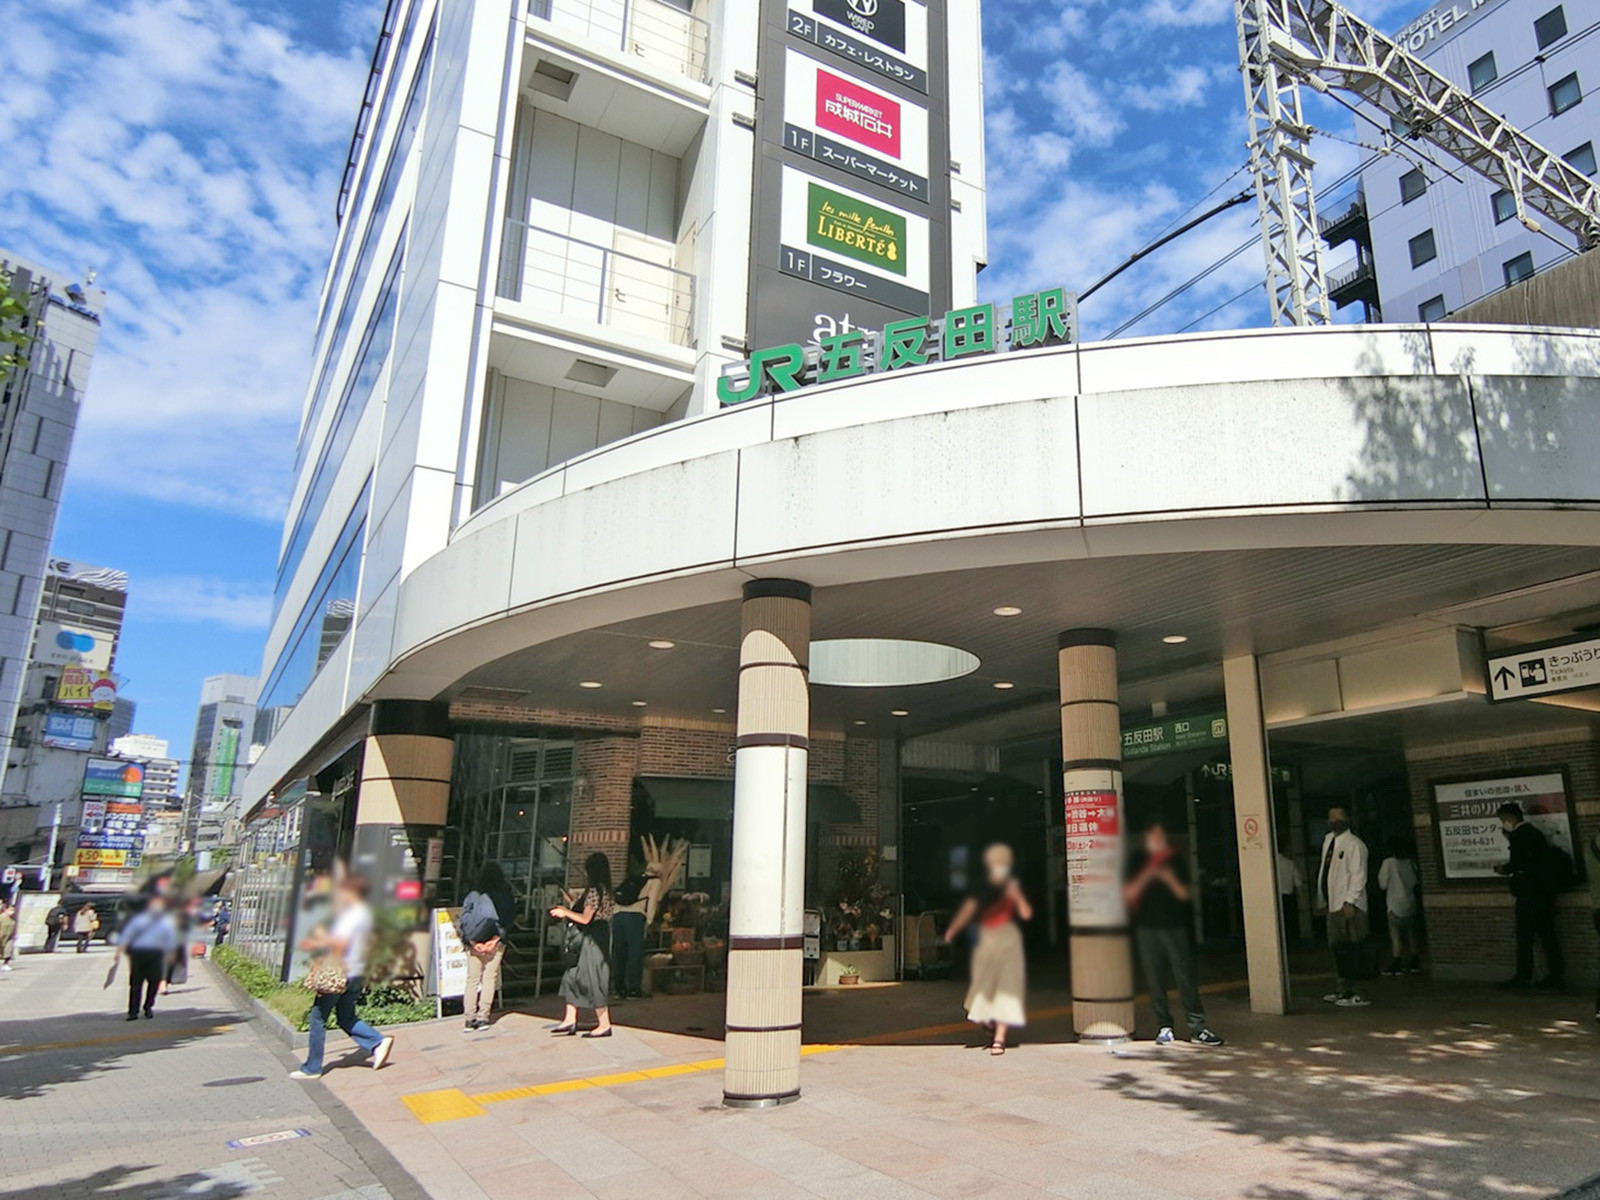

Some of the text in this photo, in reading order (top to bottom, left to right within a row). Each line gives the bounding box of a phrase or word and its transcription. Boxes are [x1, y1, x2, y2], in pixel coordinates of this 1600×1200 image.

[846, 10, 875, 30] WIRED
[792, 16, 915, 81] 2F カフェ・レストラン
[825, 99, 893, 139] 成城石井
[835, 93, 883, 119] SUPERMARKET
[791, 130, 918, 193] 1F スーパーマーケット
[817, 215, 886, 256] LIBERTÉ
[787, 252, 867, 289] 1F フラワー
[1123, 726, 1165, 747] 五反田駅
[1210, 763, 1228, 776] JR
